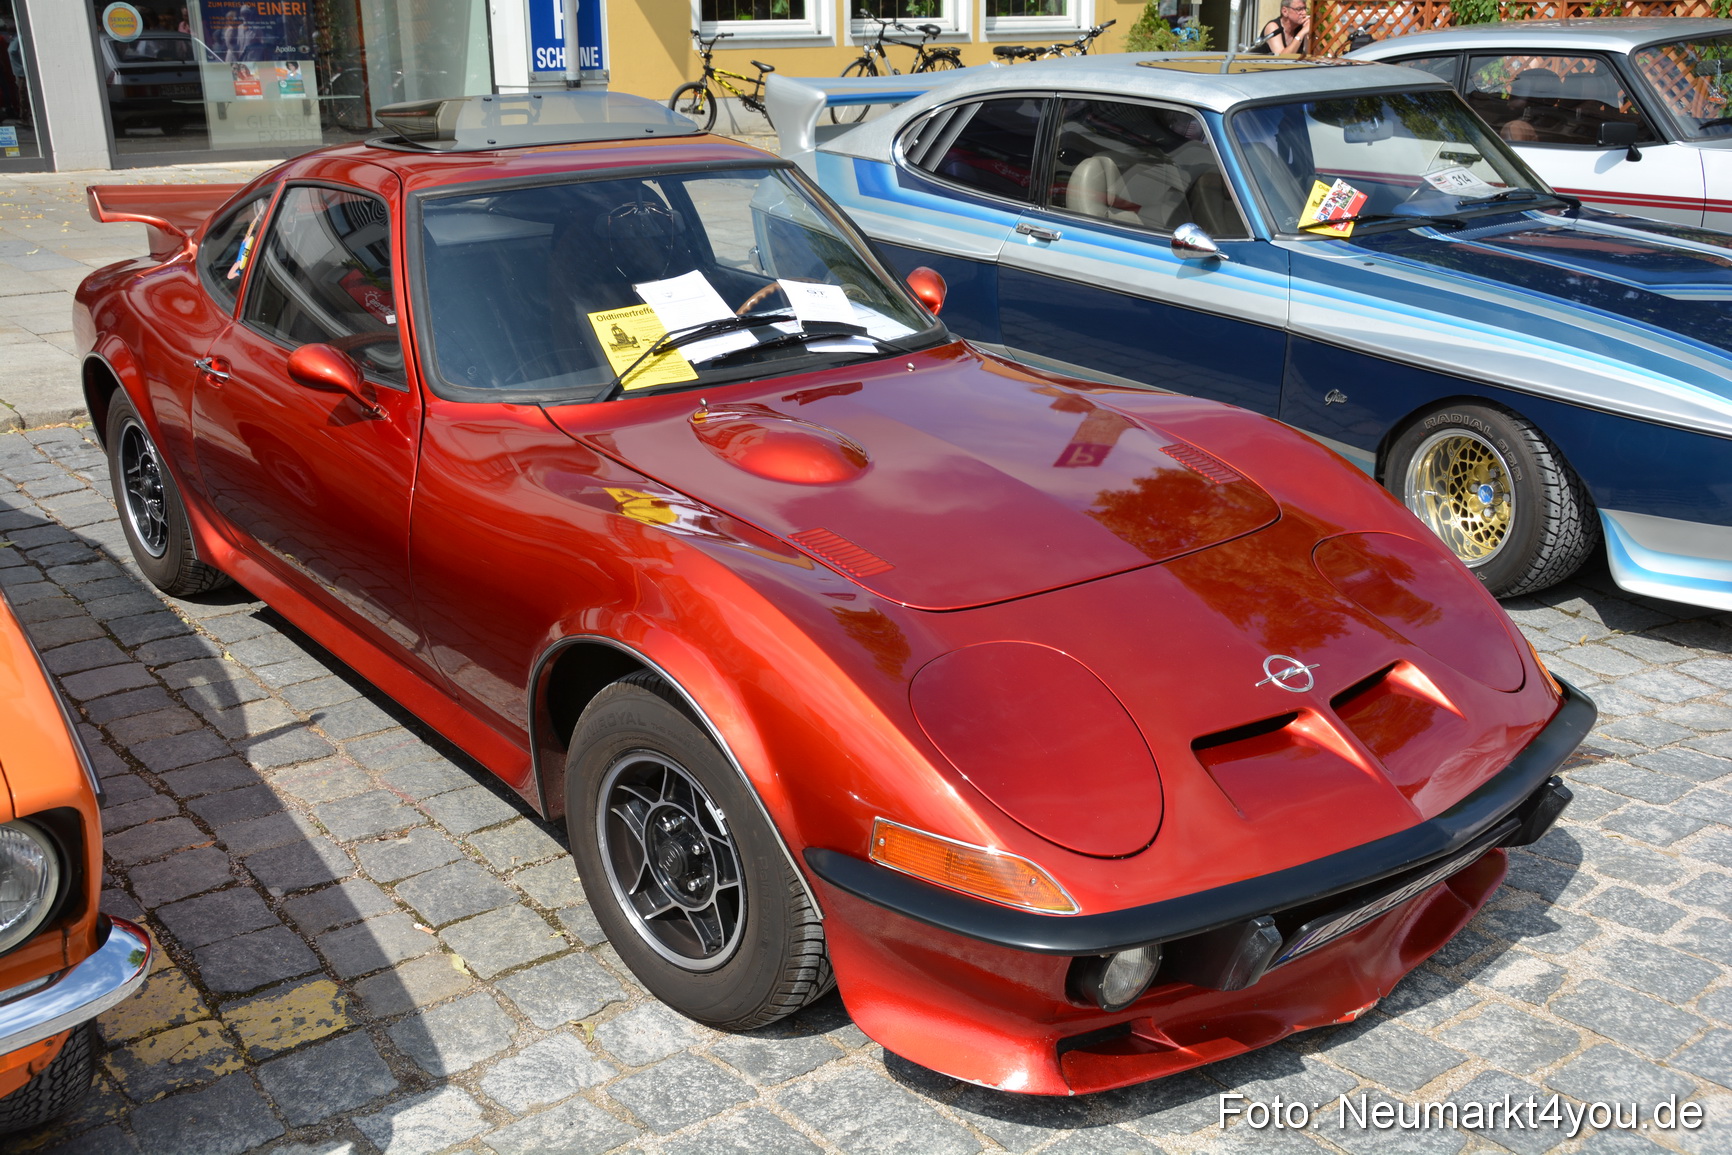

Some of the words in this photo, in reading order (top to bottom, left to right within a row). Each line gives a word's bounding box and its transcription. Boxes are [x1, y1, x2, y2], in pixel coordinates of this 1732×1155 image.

[257, 2, 307, 15] EINER!
[275, 45, 296, 54] Apollo
[1452, 174, 1472, 186] 314
[1324, 388, 1348, 405] Ghia
[1424, 413, 1494, 439] RADIAL
